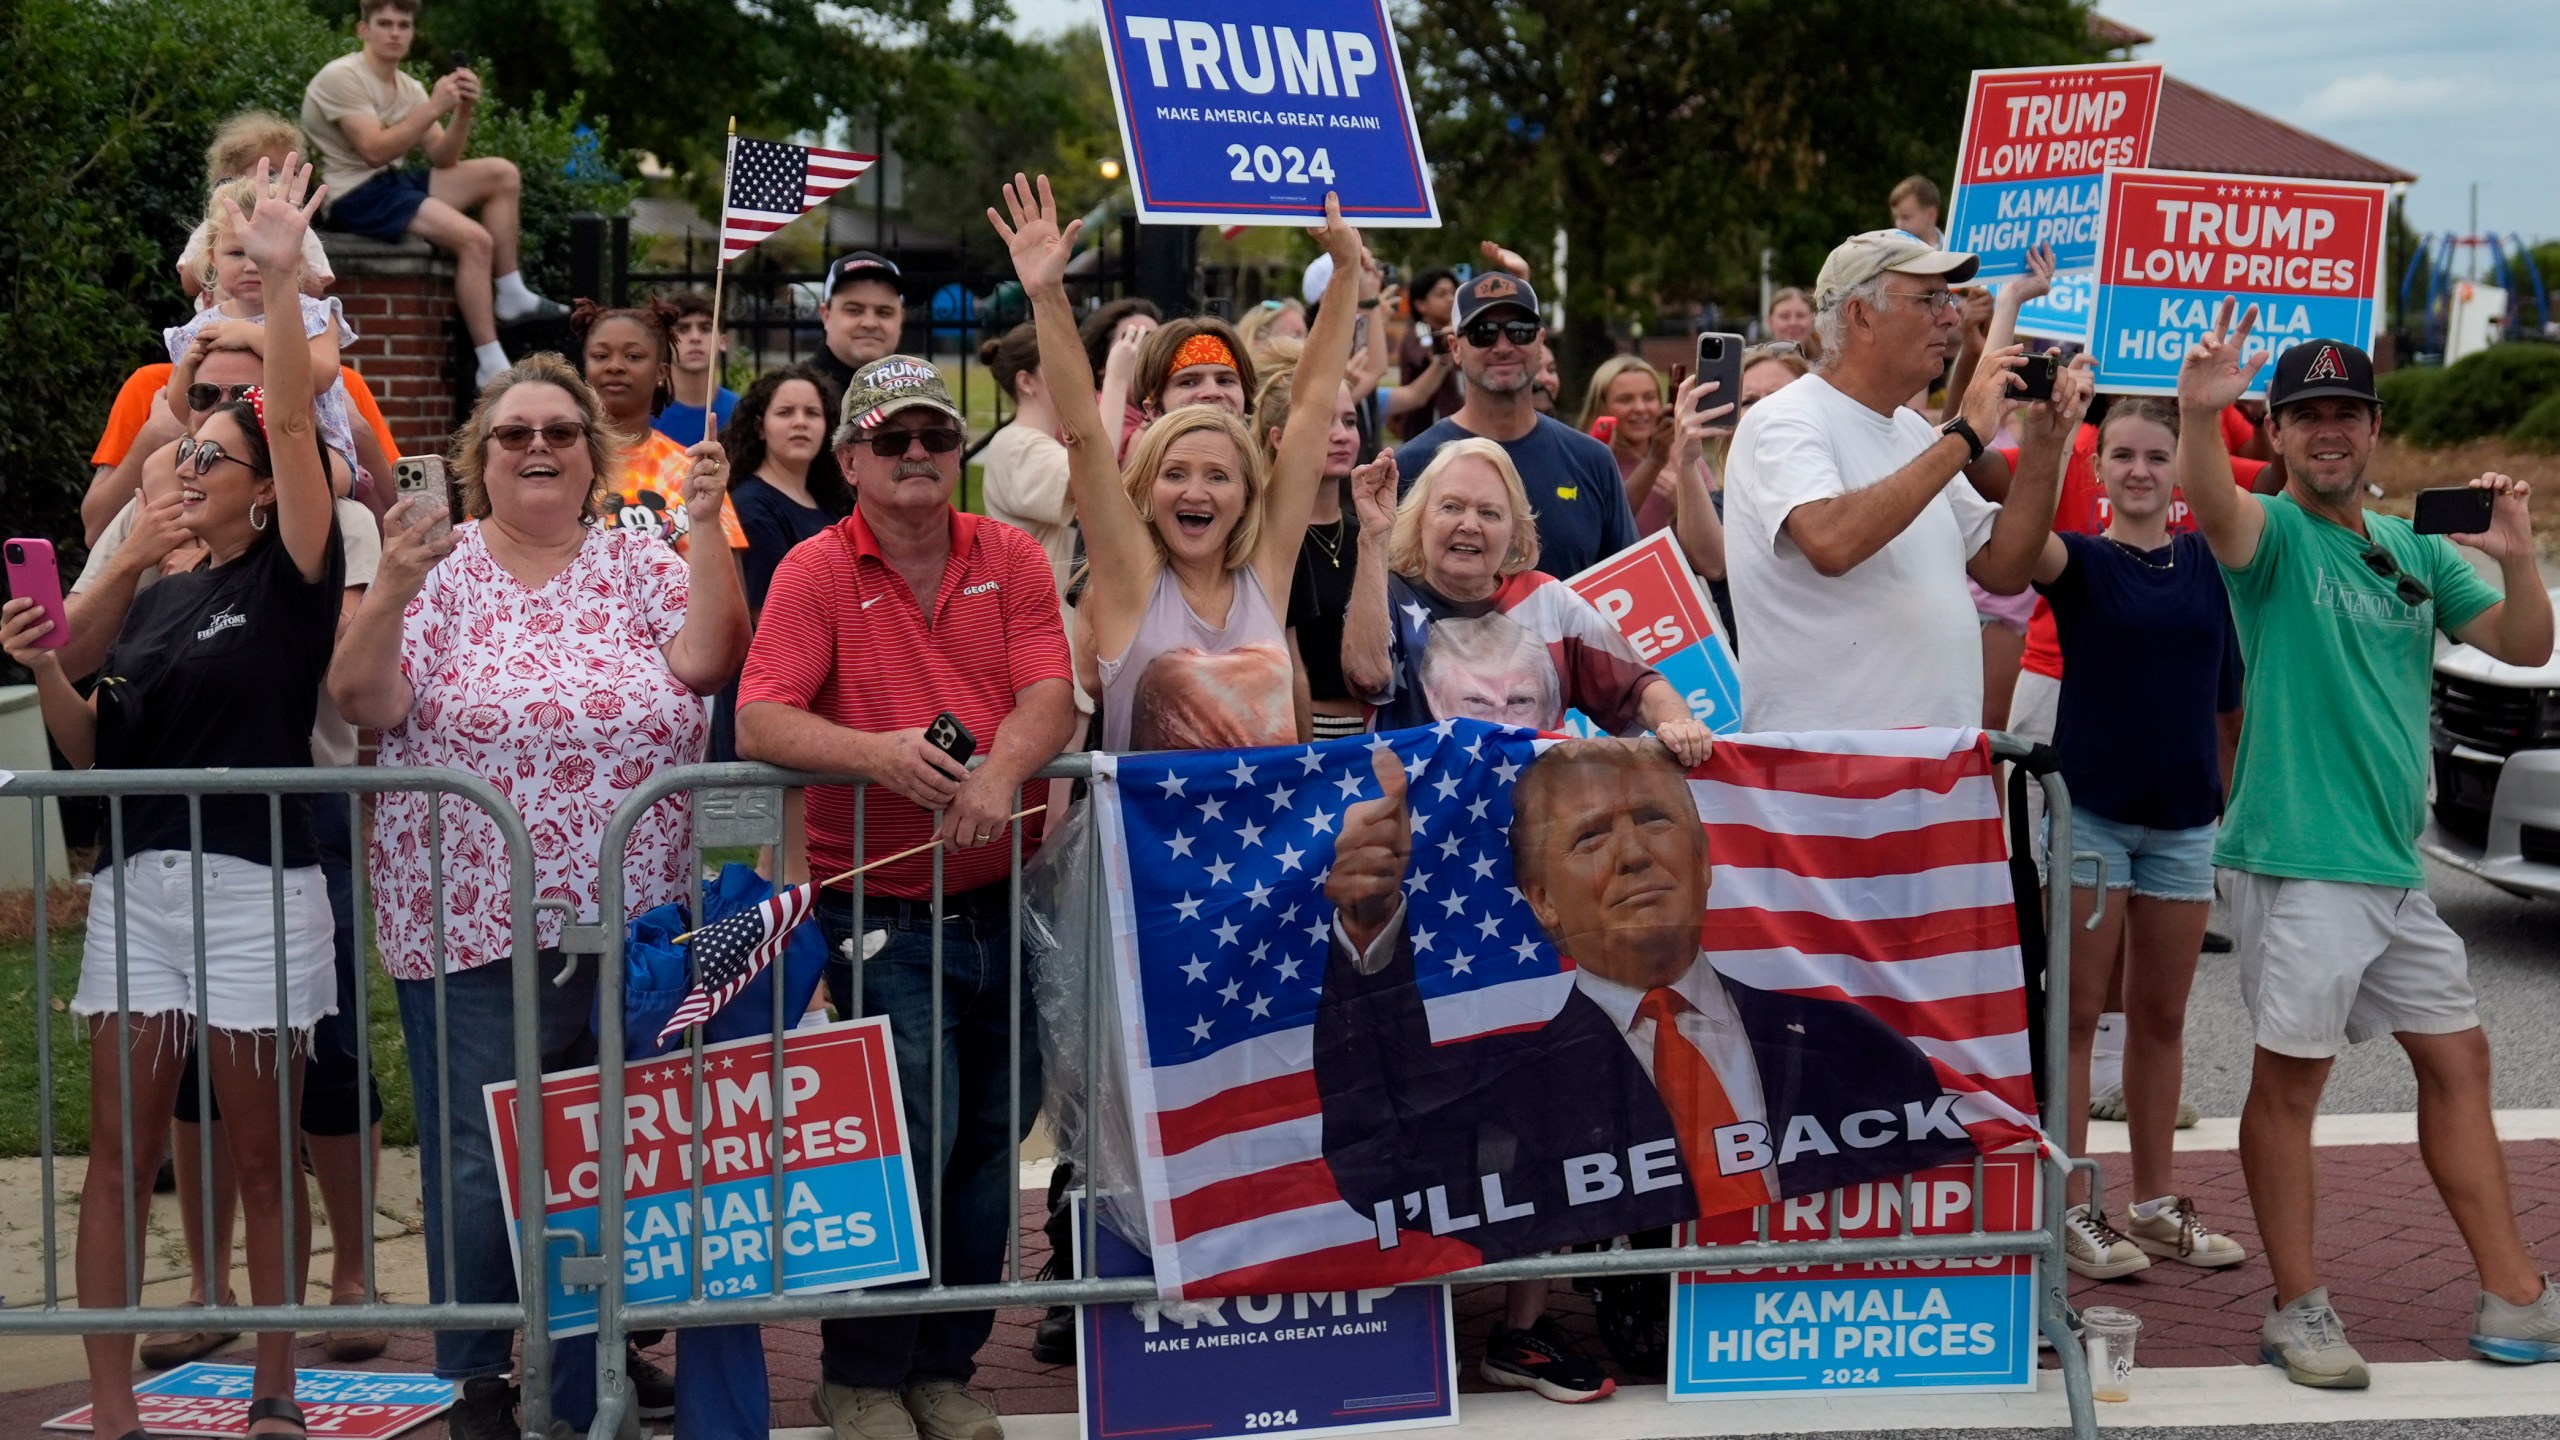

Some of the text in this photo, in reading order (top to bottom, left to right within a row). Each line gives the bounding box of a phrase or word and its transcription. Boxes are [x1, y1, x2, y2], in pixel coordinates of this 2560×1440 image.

[1125, 15, 1377, 98] TRUMP
[1157, 106, 1380, 129] MAKE AMERICA GREAT AGAIN!
[2006, 90, 2127, 138] TRUMP
[1226, 143, 1336, 184] 2024
[1976, 135, 2136, 177] LOW PRICES
[1997, 183, 2100, 220] KAMALA
[1967, 213, 2100, 253] HIGH PRICE
[2156, 199, 2336, 251] TRUMP
[2122, 247, 2355, 291] LOW PRICES
[863, 362, 935, 388] TRUMP
[886, 378, 921, 391] 2024
[963, 581, 1000, 595] GEOR
[563, 1065, 821, 1153] TRUMP
[544, 1116, 867, 1206] LOW PRICES
[1562, 1137, 1685, 1207] BE
[1712, 1094, 1973, 1177] BACK
[702, 1211, 877, 1271] PRICES
[1754, 1287, 1952, 1325] KAMALA
[1144, 1320, 1388, 1353] MAKE AMERICA GREAT AGAIN!
[1707, 1322, 1996, 1363] HIGH PRICES
[1821, 1367, 1880, 1385] 2024
[1245, 1409, 1299, 1429] 2024
